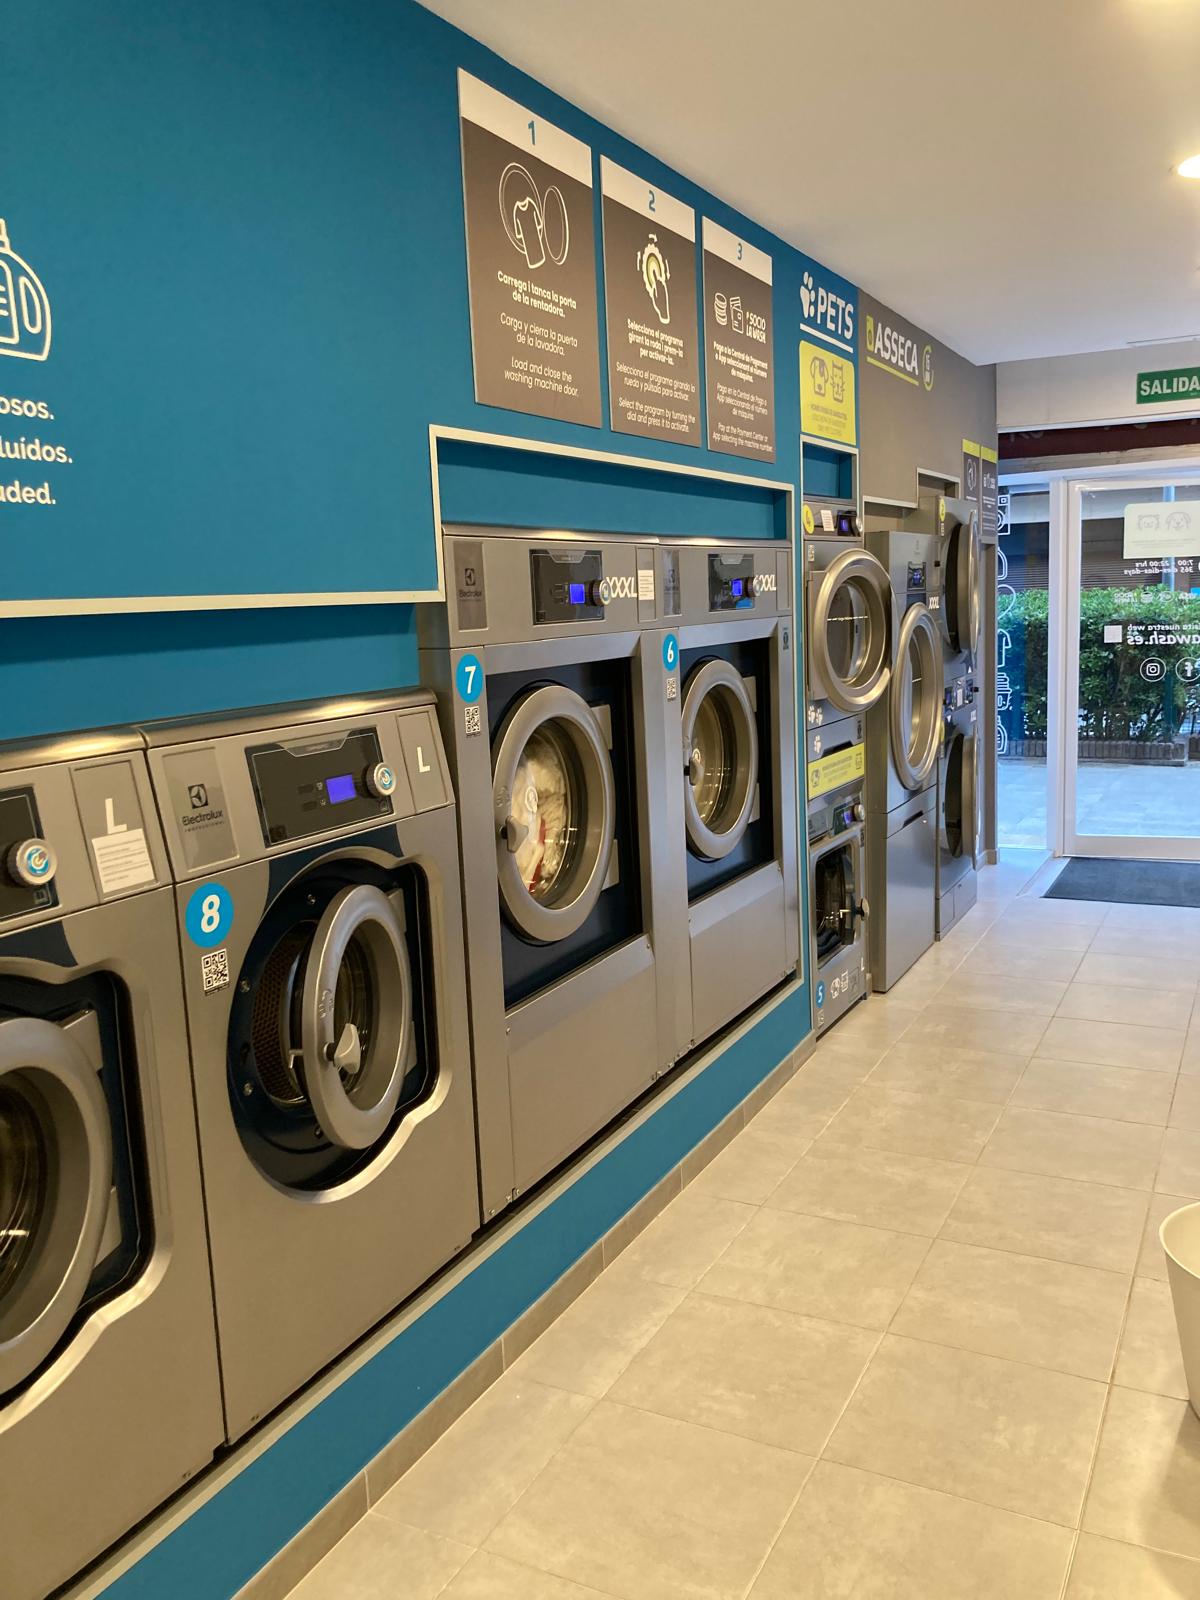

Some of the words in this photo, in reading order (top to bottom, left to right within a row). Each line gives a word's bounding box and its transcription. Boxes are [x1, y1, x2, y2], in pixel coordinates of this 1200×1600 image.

[527, 120, 537, 146] 1
[649, 190, 657, 212] 2
[736, 242, 743, 261] 3
[497, 270, 527, 293] Carrega
[527, 280, 531, 292] i
[531, 283, 551, 300] tanca
[551, 290, 558, 302] la
[559, 295, 577, 309] porta
[512, 290, 522, 302] de
[522, 292, 530, 305] la
[530, 297, 566, 318] rentadora.
[816, 286, 855, 340] PETS
[500, 312, 523, 331] Carga
[523, 322, 529, 334] y
[529, 322, 549, 338] cierra
[549, 328, 556, 340] la
[557, 332, 578, 348] puerta
[627, 318, 655, 338] Selecciona
[660, 332, 683, 347] programa
[628, 331, 645, 344] girant
[516, 332, 526, 344] de
[526, 334, 534, 346] la
[534, 336, 566, 356] lavadora.
[639, 347, 649, 358] per
[874, 322, 919, 376] ASSECA
[504, 370, 533, 389] washing
[534, 377, 562, 393] machine
[511, 356, 528, 371] Load
[529, 363, 543, 375] and
[543, 366, 561, 380] close
[561, 370, 572, 383] the
[616, 361, 644, 378] Selecciona
[649, 373, 673, 386] programa
[1140, 375, 1200, 397] SALIDA
[618, 396, 635, 409] Select
[643, 404, 665, 417] program
[666, 640, 675, 663] 6
[464, 665, 476, 694] 7
[416, 746, 431, 773] L
[105, 798, 127, 834] L
[181, 810, 223, 827] Electrolux
[200, 895, 220, 933] 8
[818, 985, 823, 1003] 5
